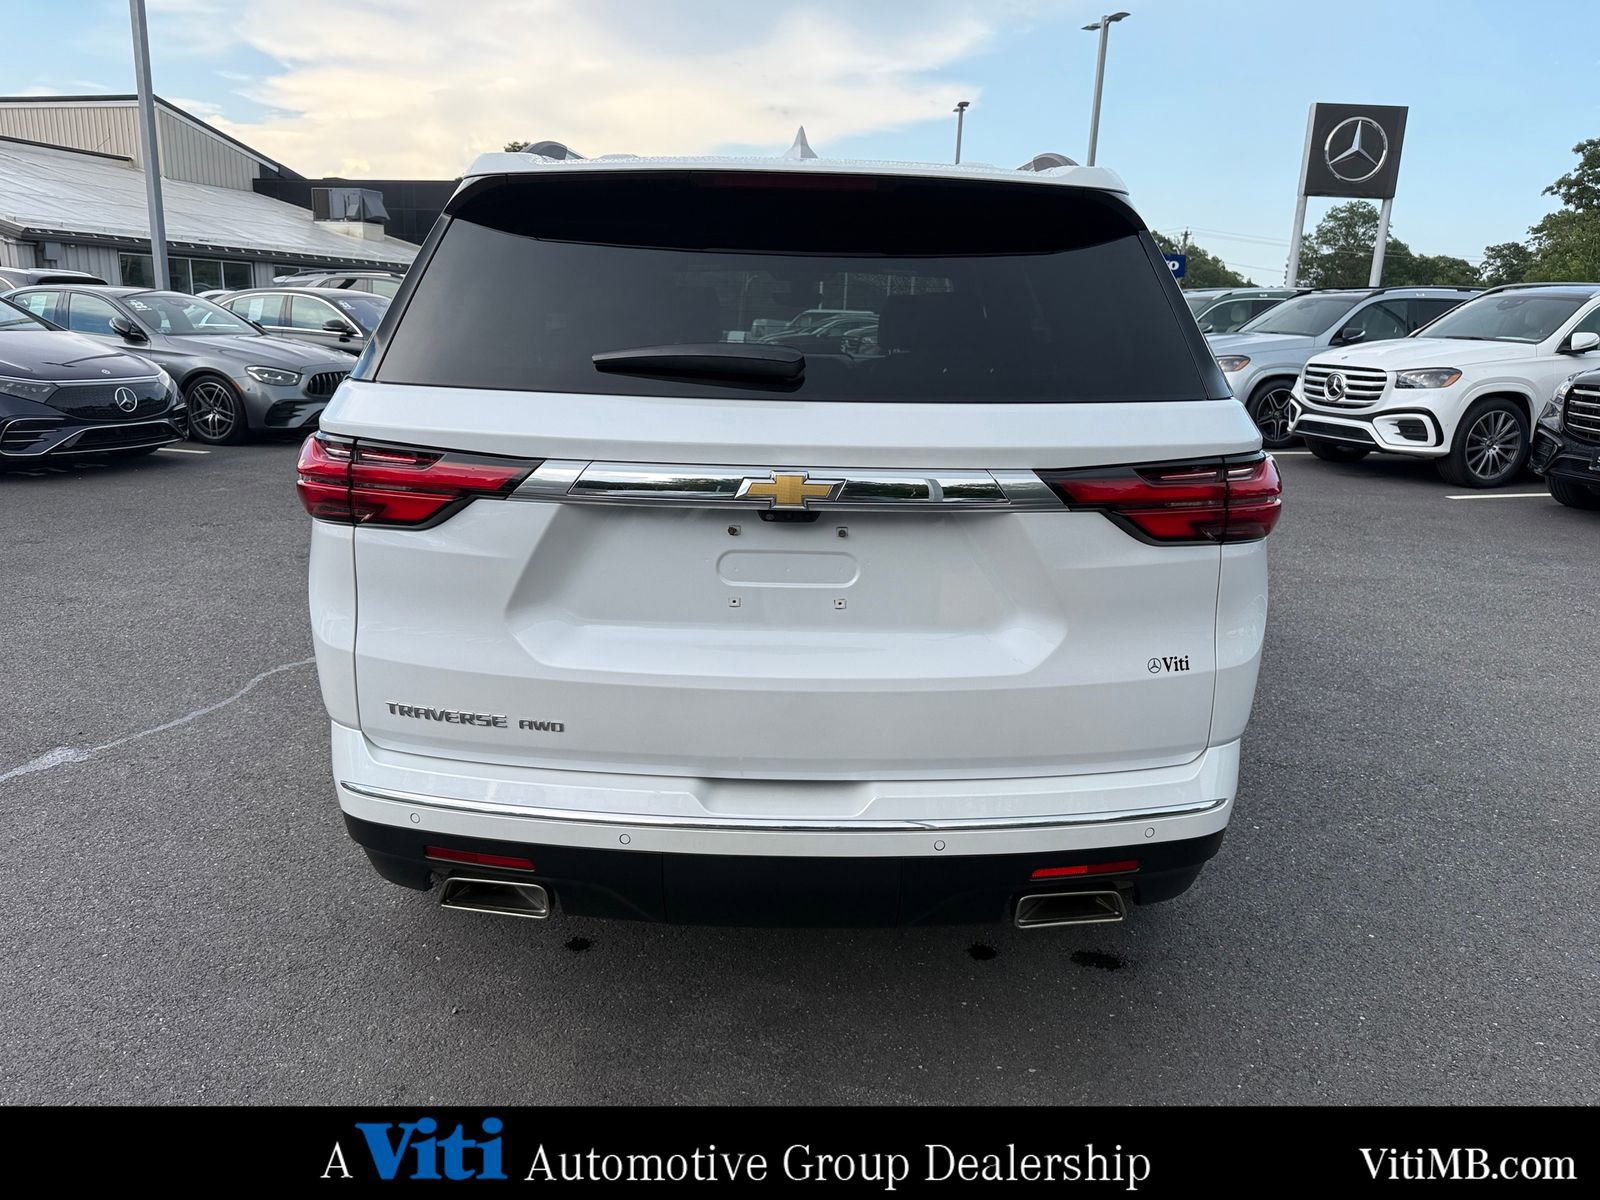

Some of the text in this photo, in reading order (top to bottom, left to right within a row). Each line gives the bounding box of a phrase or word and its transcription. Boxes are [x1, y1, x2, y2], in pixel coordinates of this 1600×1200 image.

[1162, 655, 1190, 673] Viti
[385, 701, 566, 733] TRAVERSE AWD
